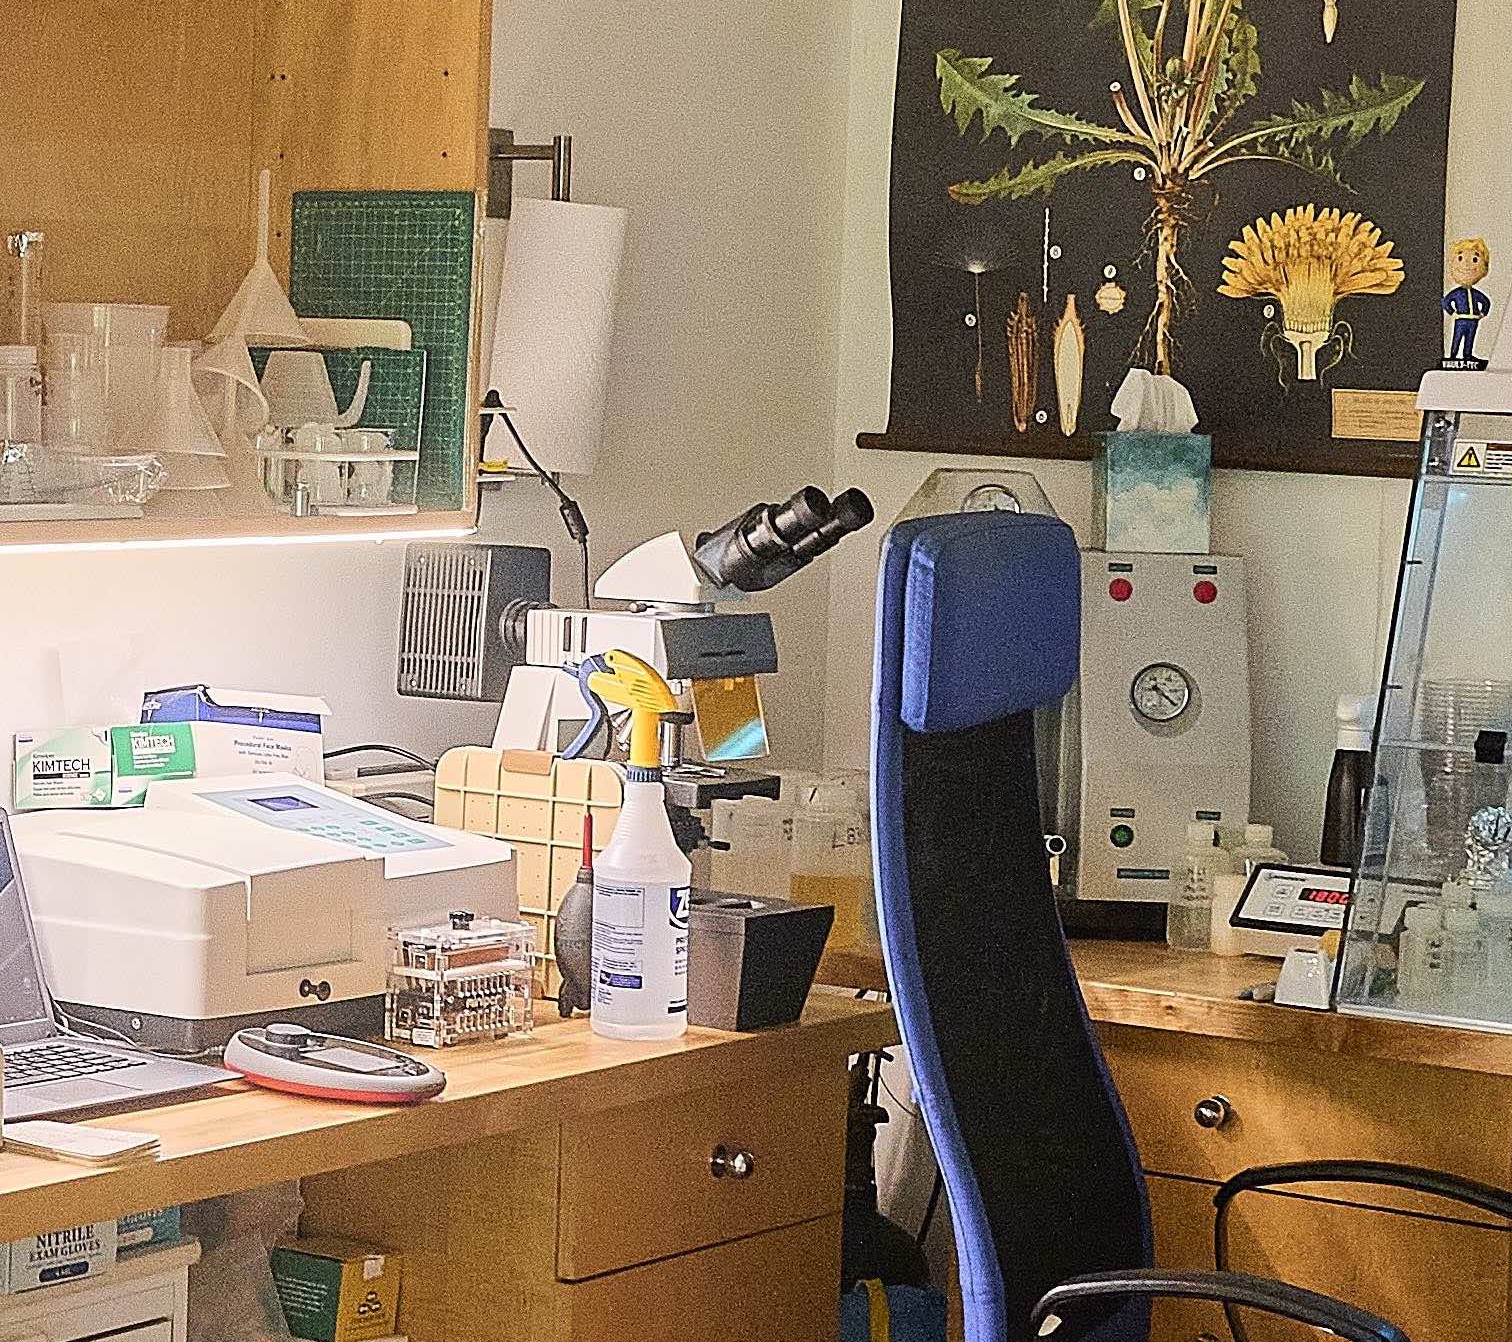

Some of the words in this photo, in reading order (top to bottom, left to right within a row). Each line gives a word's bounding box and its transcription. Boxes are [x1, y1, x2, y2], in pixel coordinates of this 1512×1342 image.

[33, 759, 90, 773] KIMTECH
[36, 1224, 94, 1249] NITRILE
[29, 1246, 58, 1261] EXAM
[61, 1239, 100, 1257] GLOVES
